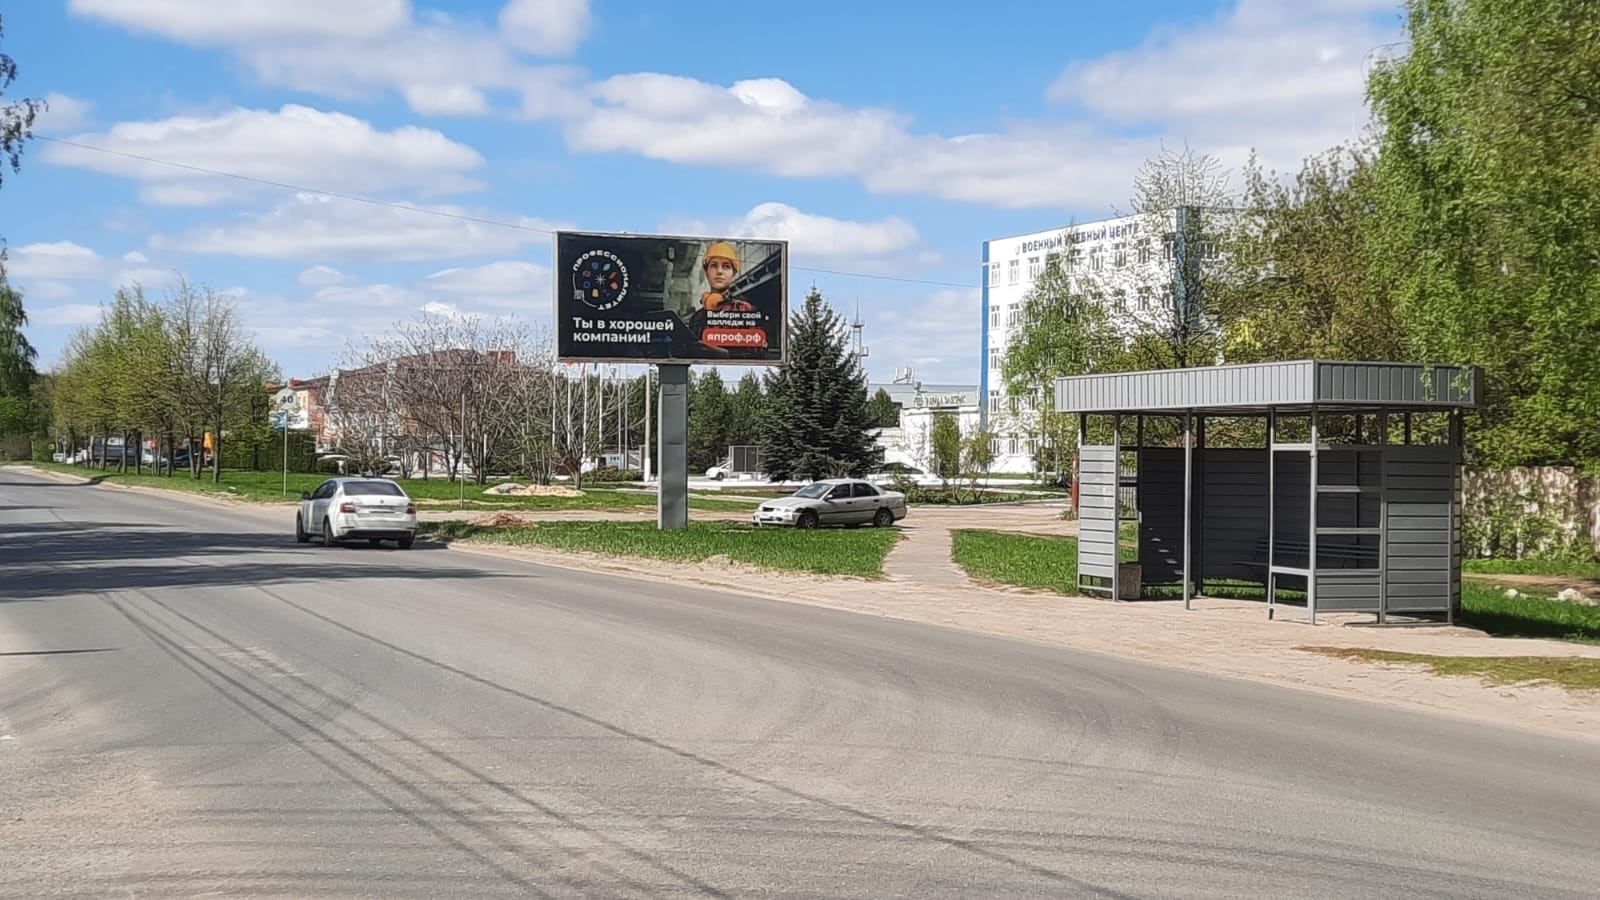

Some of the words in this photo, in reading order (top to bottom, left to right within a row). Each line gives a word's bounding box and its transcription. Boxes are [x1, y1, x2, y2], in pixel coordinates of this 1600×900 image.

[1022, 233, 1062, 253] ВОЕННЫЙ
[1109, 222, 1140, 240] ЦЕНТР
[573, 250, 629, 310] ПРОФЕССИОНАЛИТЕТ
[707, 310, 740, 320] Выбери
[741, 311, 762, 319] свой
[572, 317, 593, 329] Ты
[597, 319, 606, 329] в
[609, 319, 674, 331] хорошей
[573, 332, 651, 343] компании!
[707, 332, 761, 343] япроф.рф
[280, 395, 294, 403] 40
